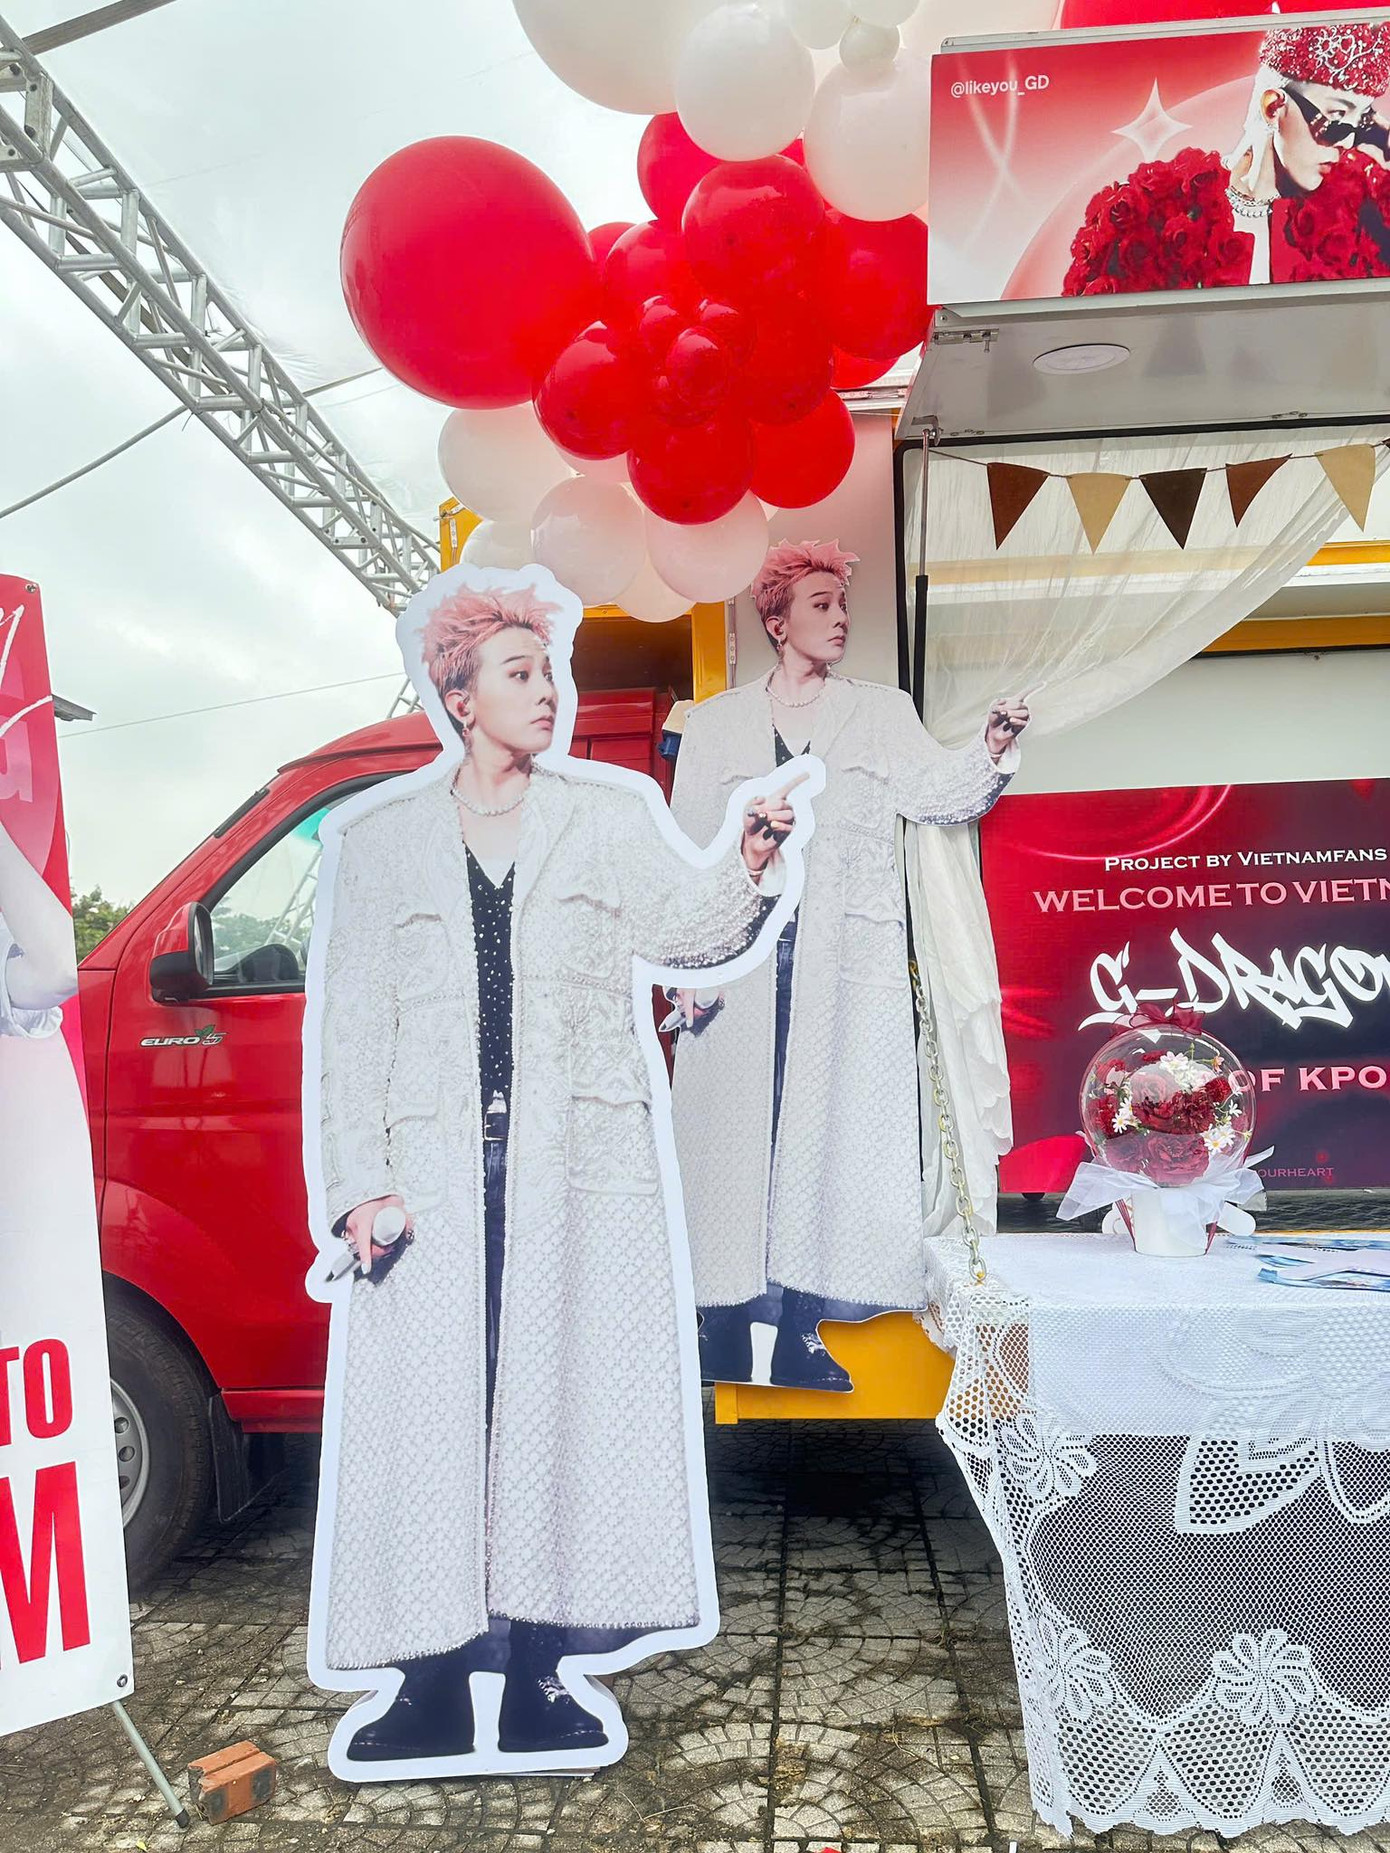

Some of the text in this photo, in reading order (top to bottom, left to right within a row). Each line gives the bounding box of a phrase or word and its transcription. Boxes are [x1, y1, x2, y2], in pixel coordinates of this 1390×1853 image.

[950, 74, 1050, 98] @likeyou_GD
[1104, 848, 1388, 872] PROJECT BY VIETNAMFANS
[1033, 884, 1233, 913] WELCOME
[1236, 881, 1287, 906] TO
[1078, 927, 1390, 1032] G-DRAGO
[140, 1032, 229, 1047] EURO 5
[1228, 1067, 1286, 1093] OF
